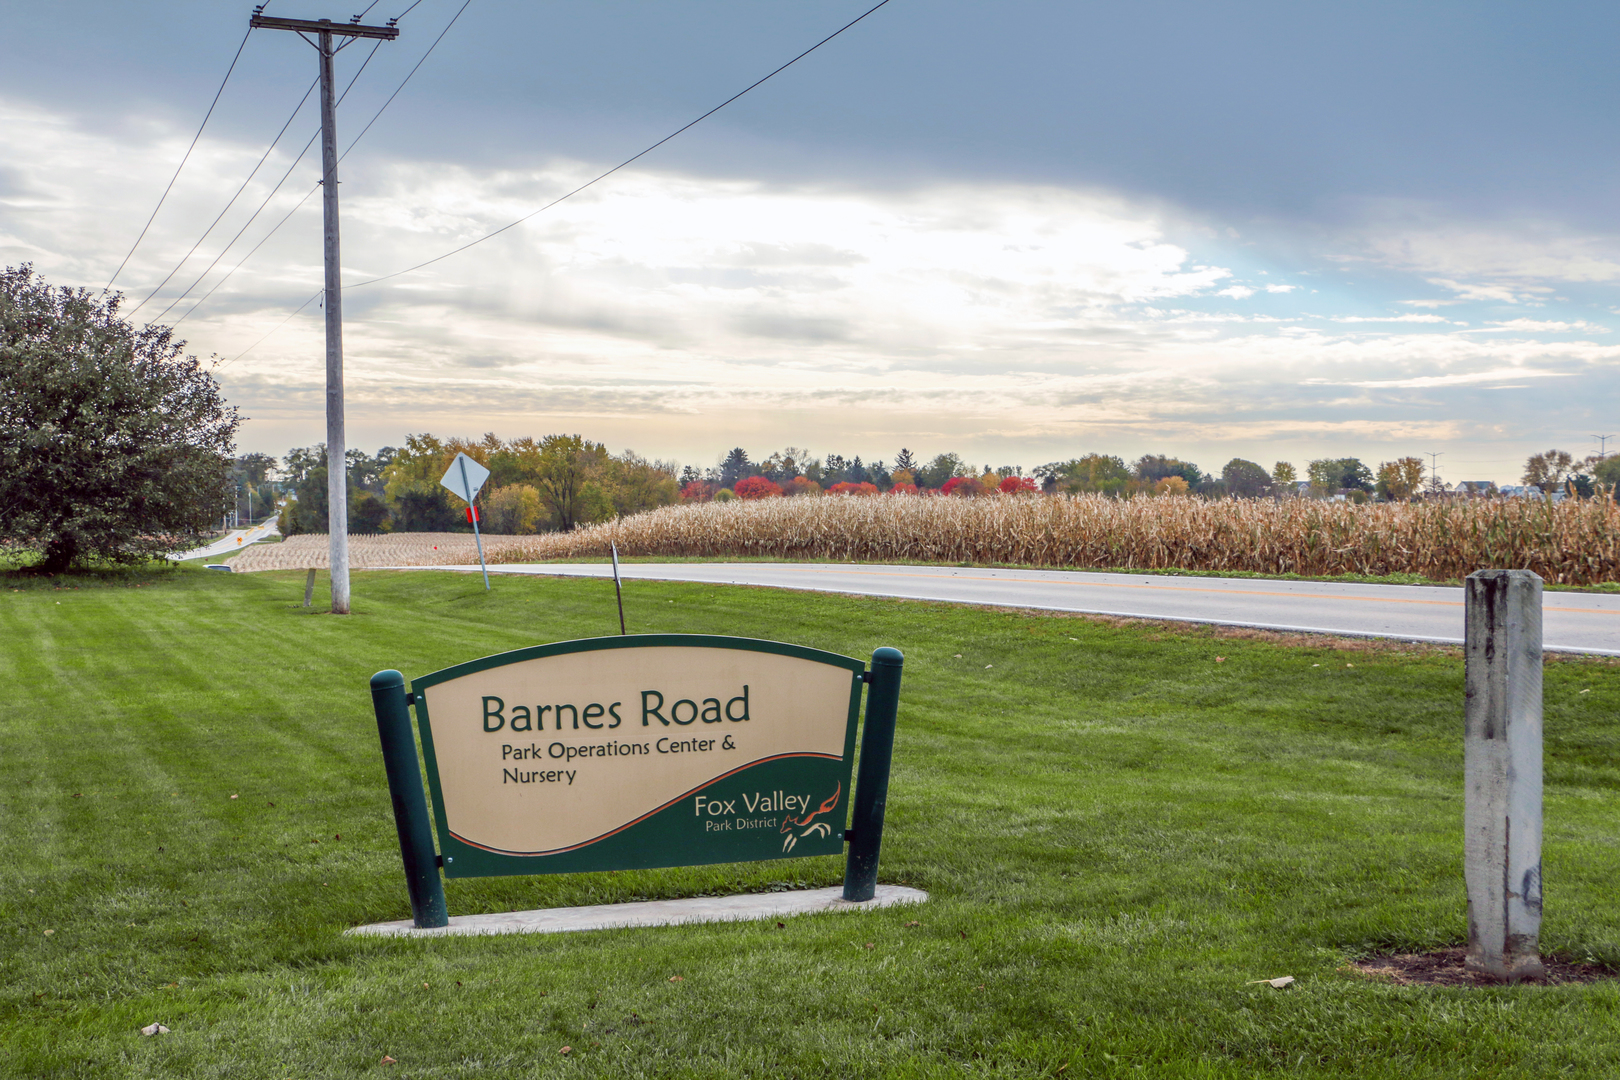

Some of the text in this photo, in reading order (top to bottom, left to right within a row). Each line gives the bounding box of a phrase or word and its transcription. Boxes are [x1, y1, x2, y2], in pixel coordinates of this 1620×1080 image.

[482, 684, 750, 733] Barnes Road
[502, 735, 736, 762] Park Operations Center &
[503, 768, 576, 785] Nursery
[695, 790, 811, 816] Fox Valley
[706, 816, 778, 832] Park District
